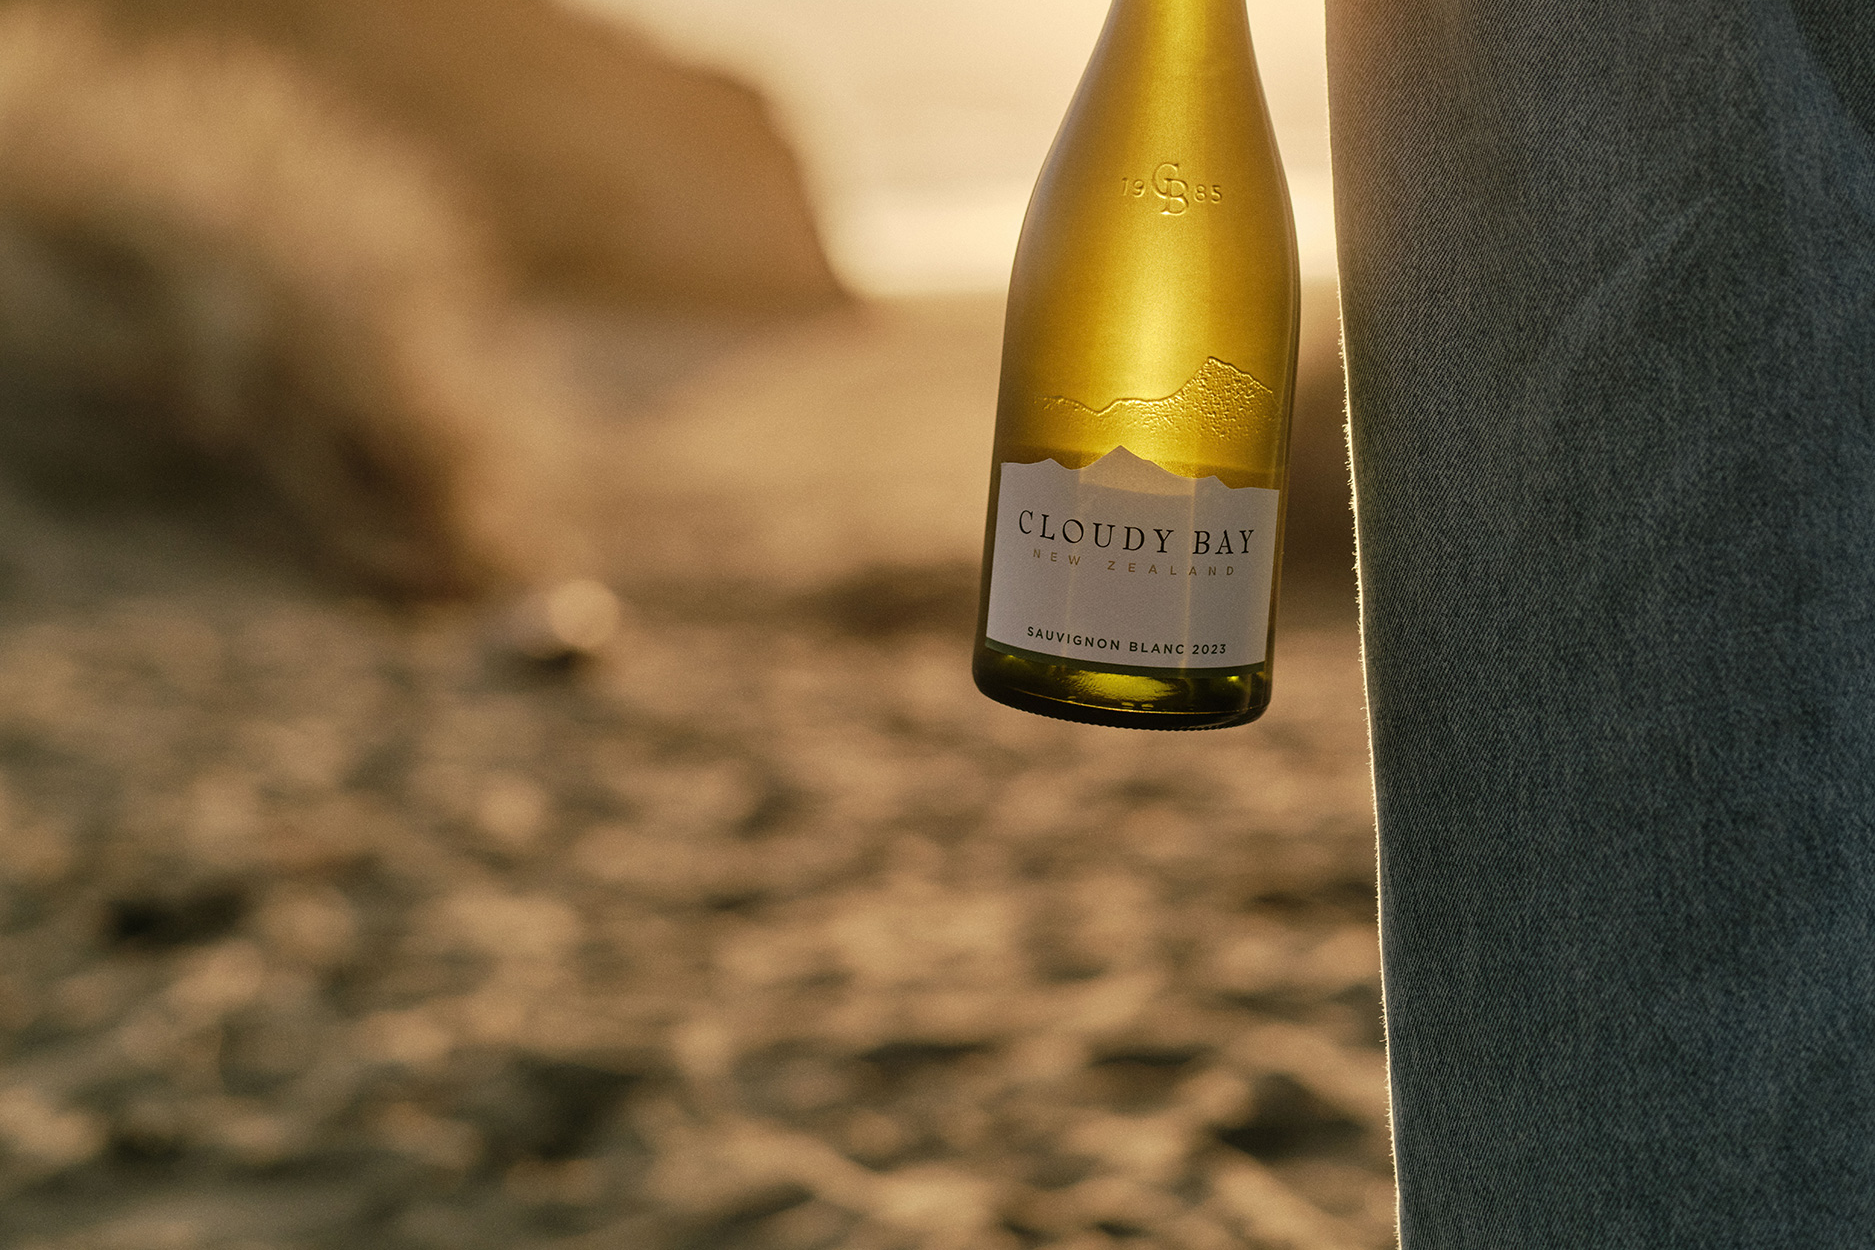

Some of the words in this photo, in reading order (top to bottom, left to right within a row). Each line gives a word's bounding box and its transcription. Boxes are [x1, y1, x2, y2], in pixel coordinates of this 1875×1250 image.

[1018, 509, 1175, 554] CLOUDY
[1192, 529, 1255, 555] BAY
[1032, 548, 1081, 566] NEW
[1106, 560, 1235, 577] ZEALAND
[1026, 625, 1121, 651] SAUVIGNON
[1128, 641, 1185, 655] BLANC
[1191, 643, 1228, 655] 2023
